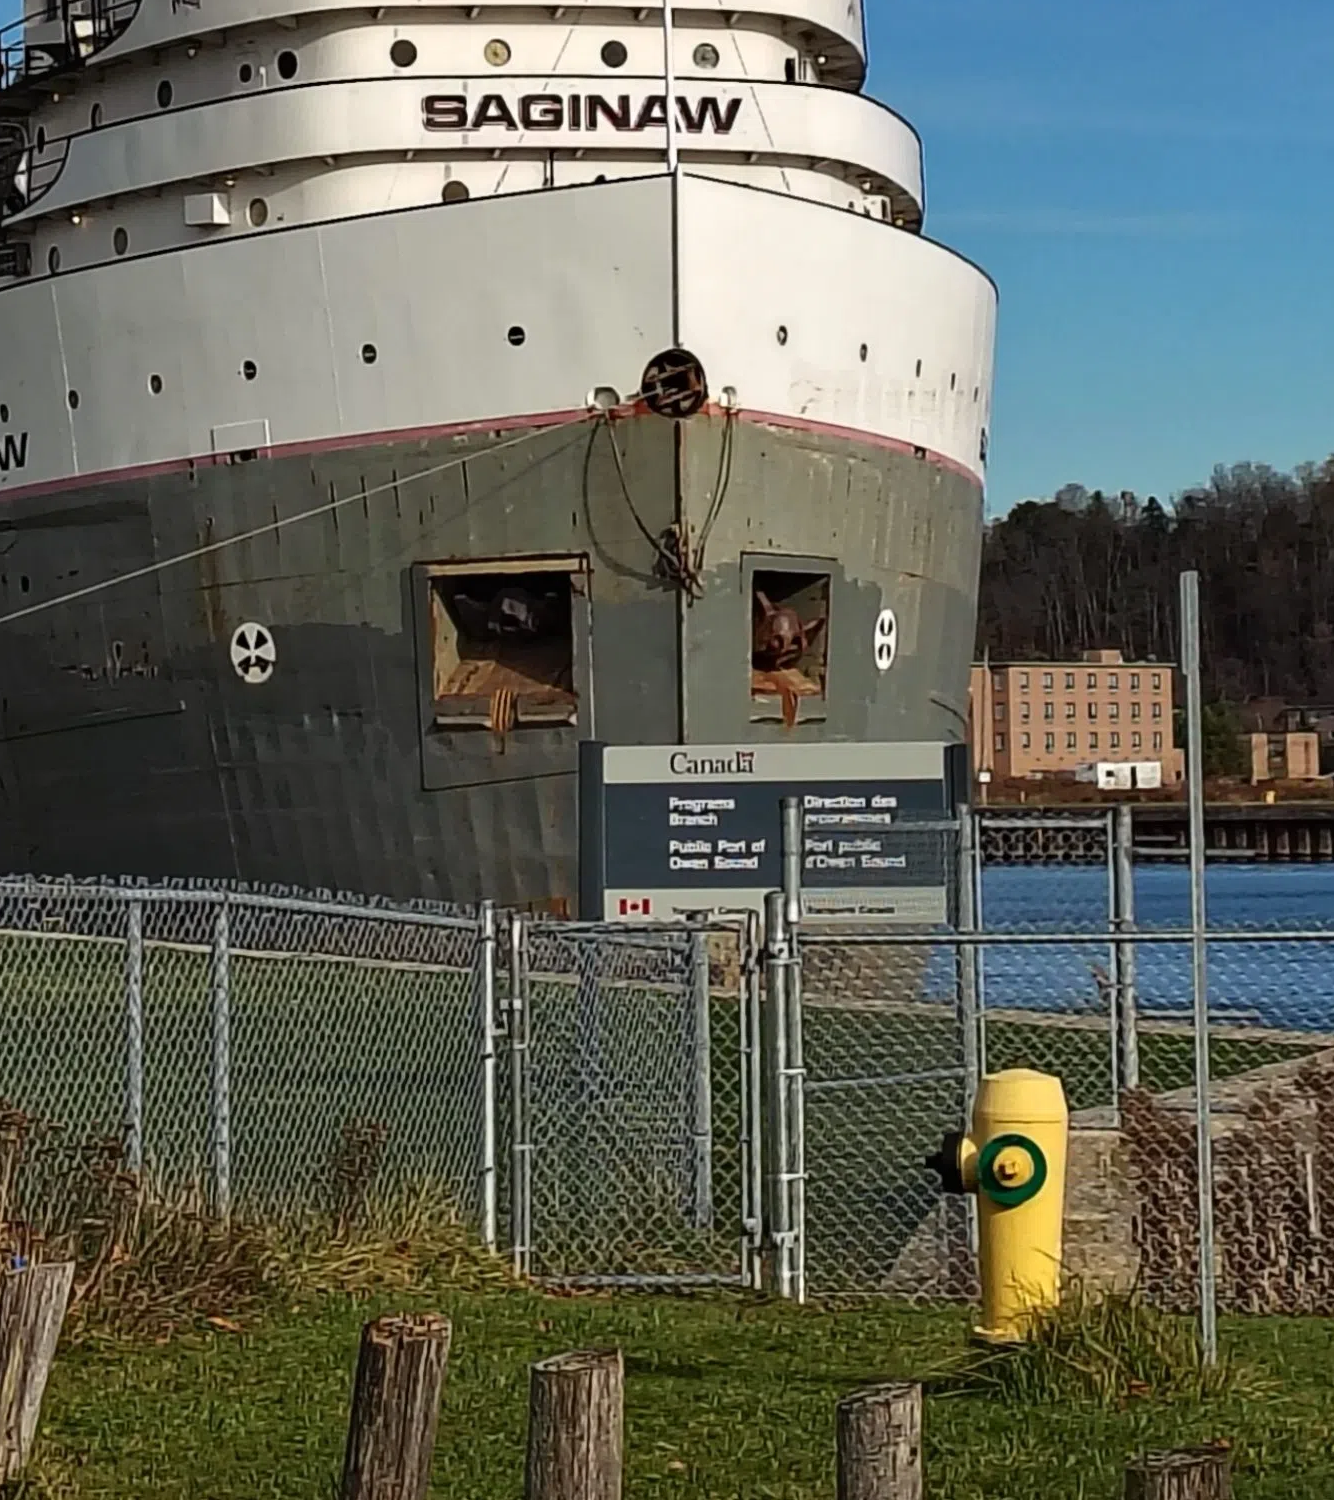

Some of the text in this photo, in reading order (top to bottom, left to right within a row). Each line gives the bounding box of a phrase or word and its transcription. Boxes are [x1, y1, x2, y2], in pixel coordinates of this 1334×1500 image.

[422, 94, 742, 134] SAGINAW
[670, 751, 755, 775] Canada
[669, 812, 718, 827] Branch
[669, 839, 766, 854] Public Port of
